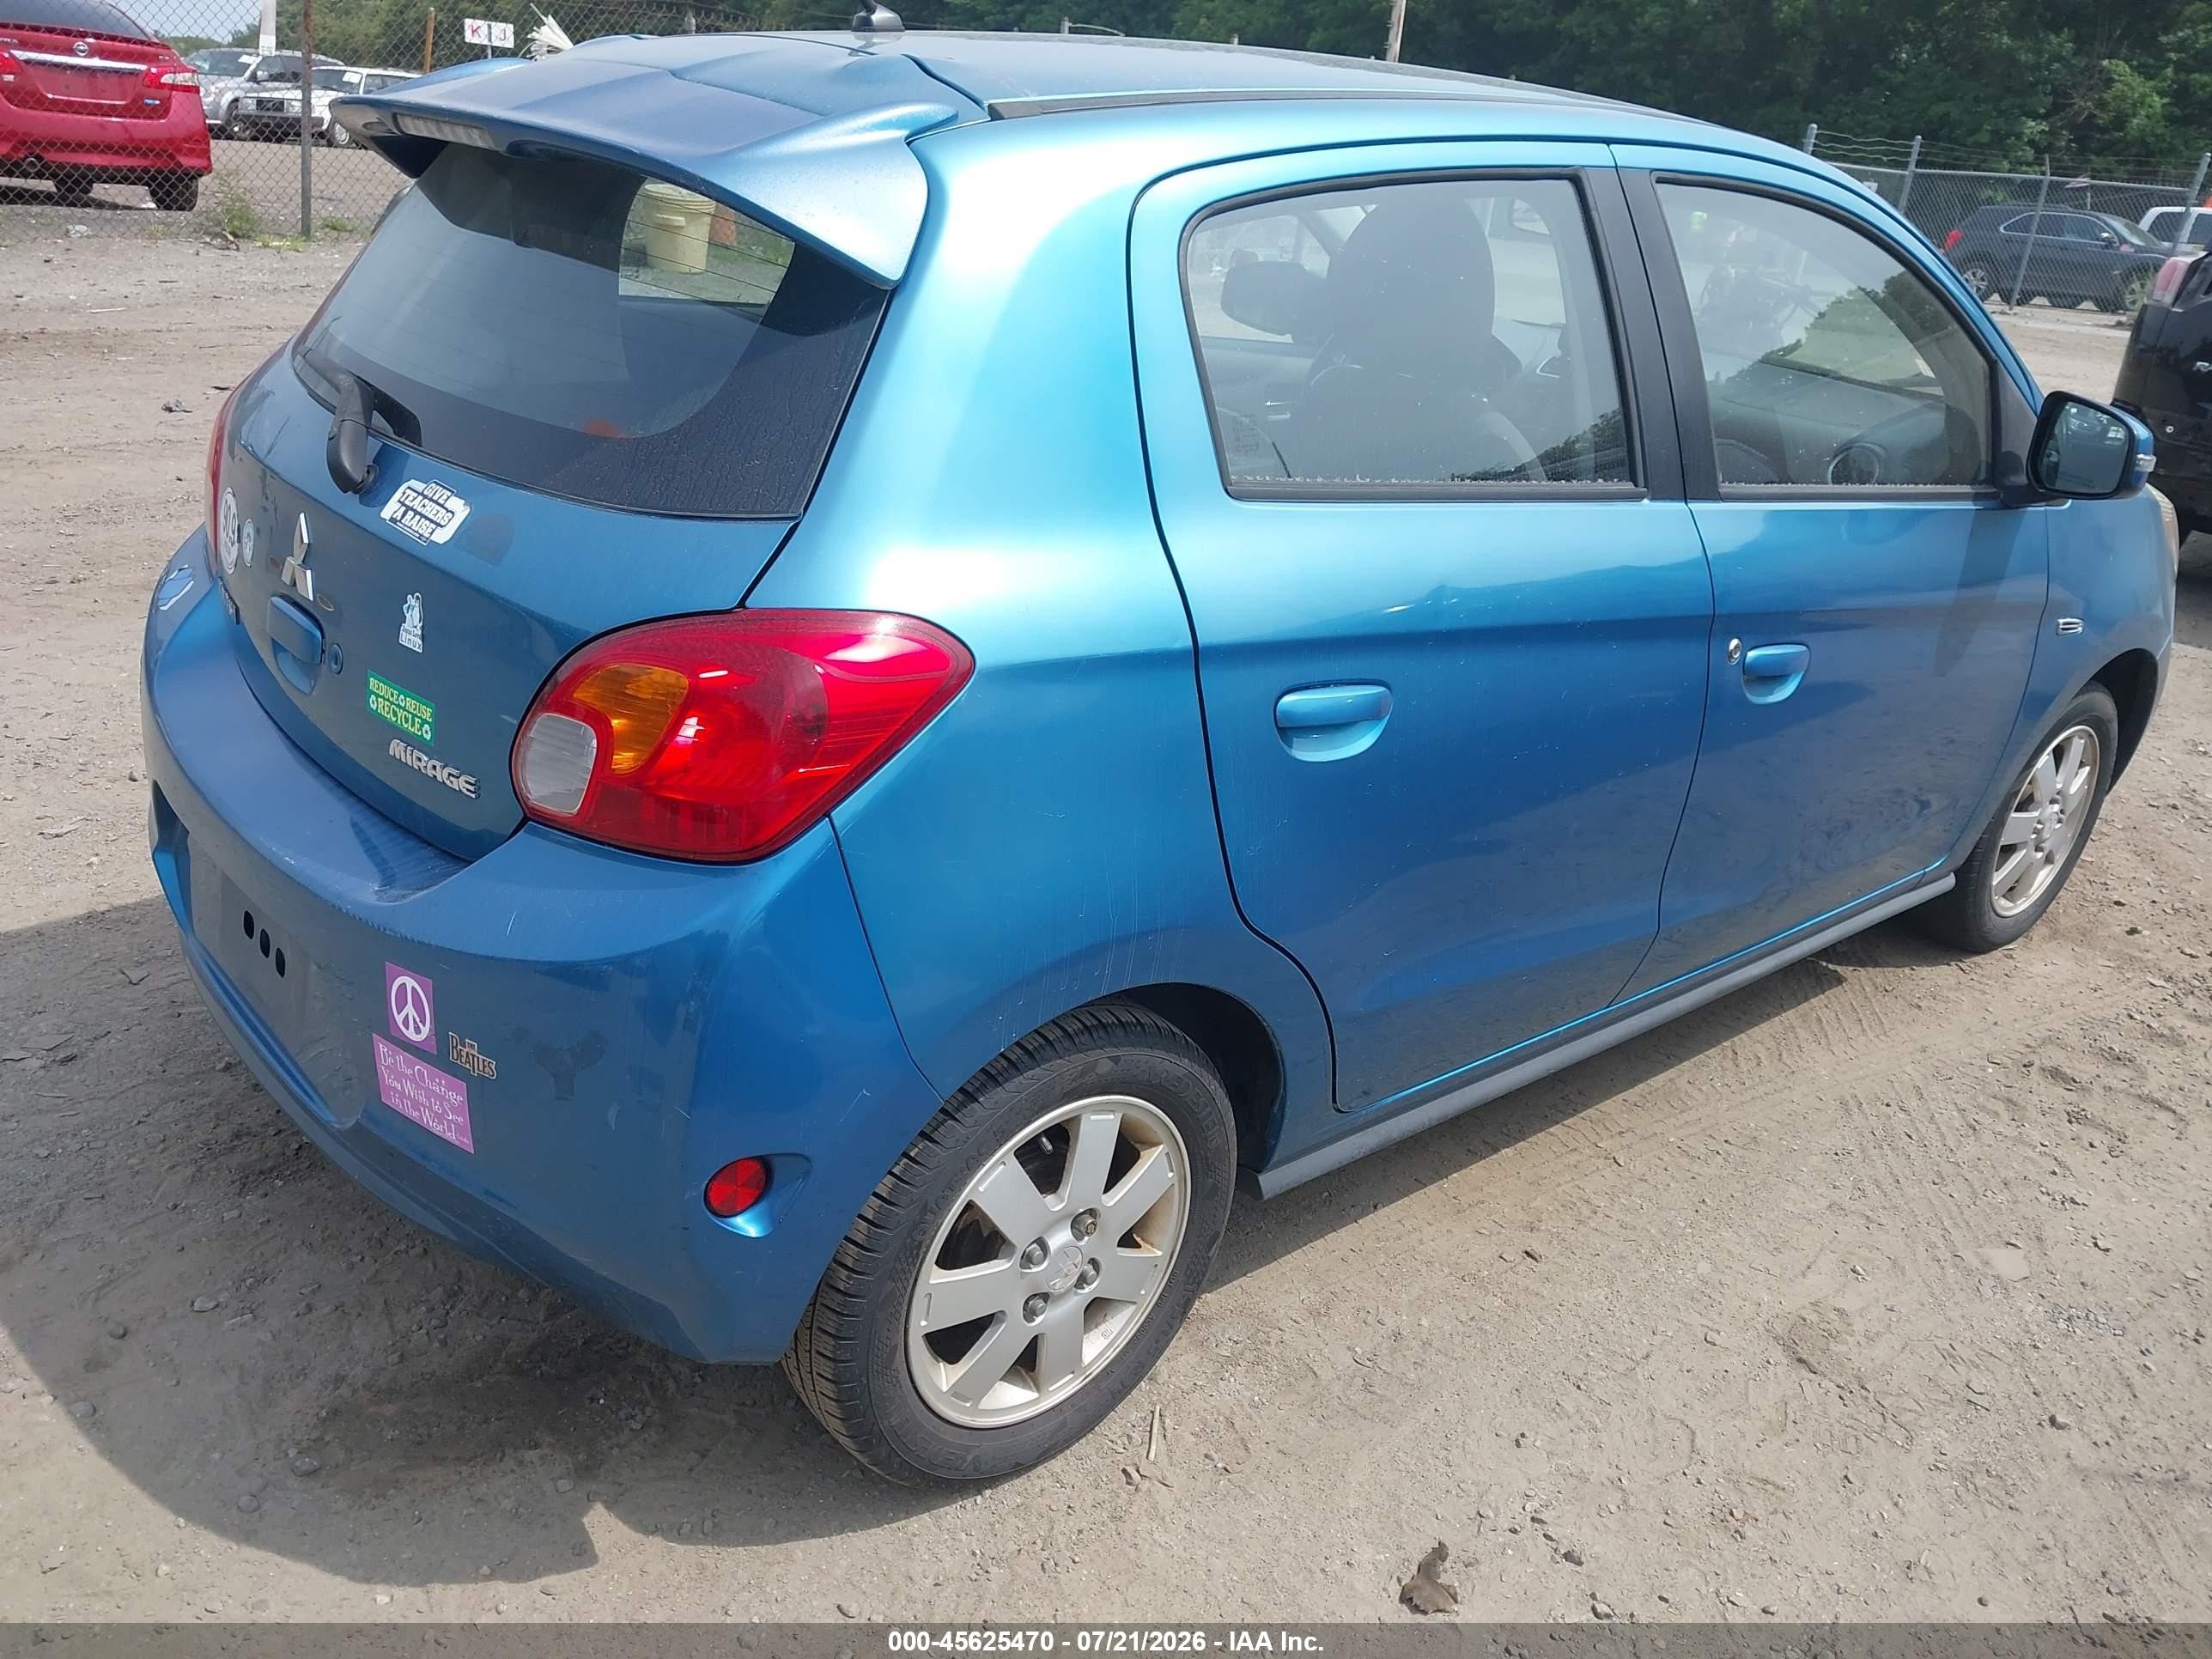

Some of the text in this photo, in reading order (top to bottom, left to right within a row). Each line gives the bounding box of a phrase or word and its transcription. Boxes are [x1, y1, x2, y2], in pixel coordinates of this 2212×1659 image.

[468, 24, 507, 41] K J
[398, 489, 454, 526] TEACHERS
[423, 482, 452, 505] GIVE
[392, 506, 406, 520] A
[401, 510, 438, 538] RAISE
[400, 631, 422, 650] Linux
[369, 677, 433, 723] REDUCE REUSE
[377, 697, 422, 736] RECYCLE
[388, 738, 481, 799] MIRAGE
[378, 1042, 464, 1108] Be the Change
[451, 1035, 495, 1078] BEATLES
[380, 1065, 465, 1126] You Wish to See
[390, 1091, 403, 1109] in
[404, 1098, 421, 1119] the
[419, 1105, 457, 1141] World
